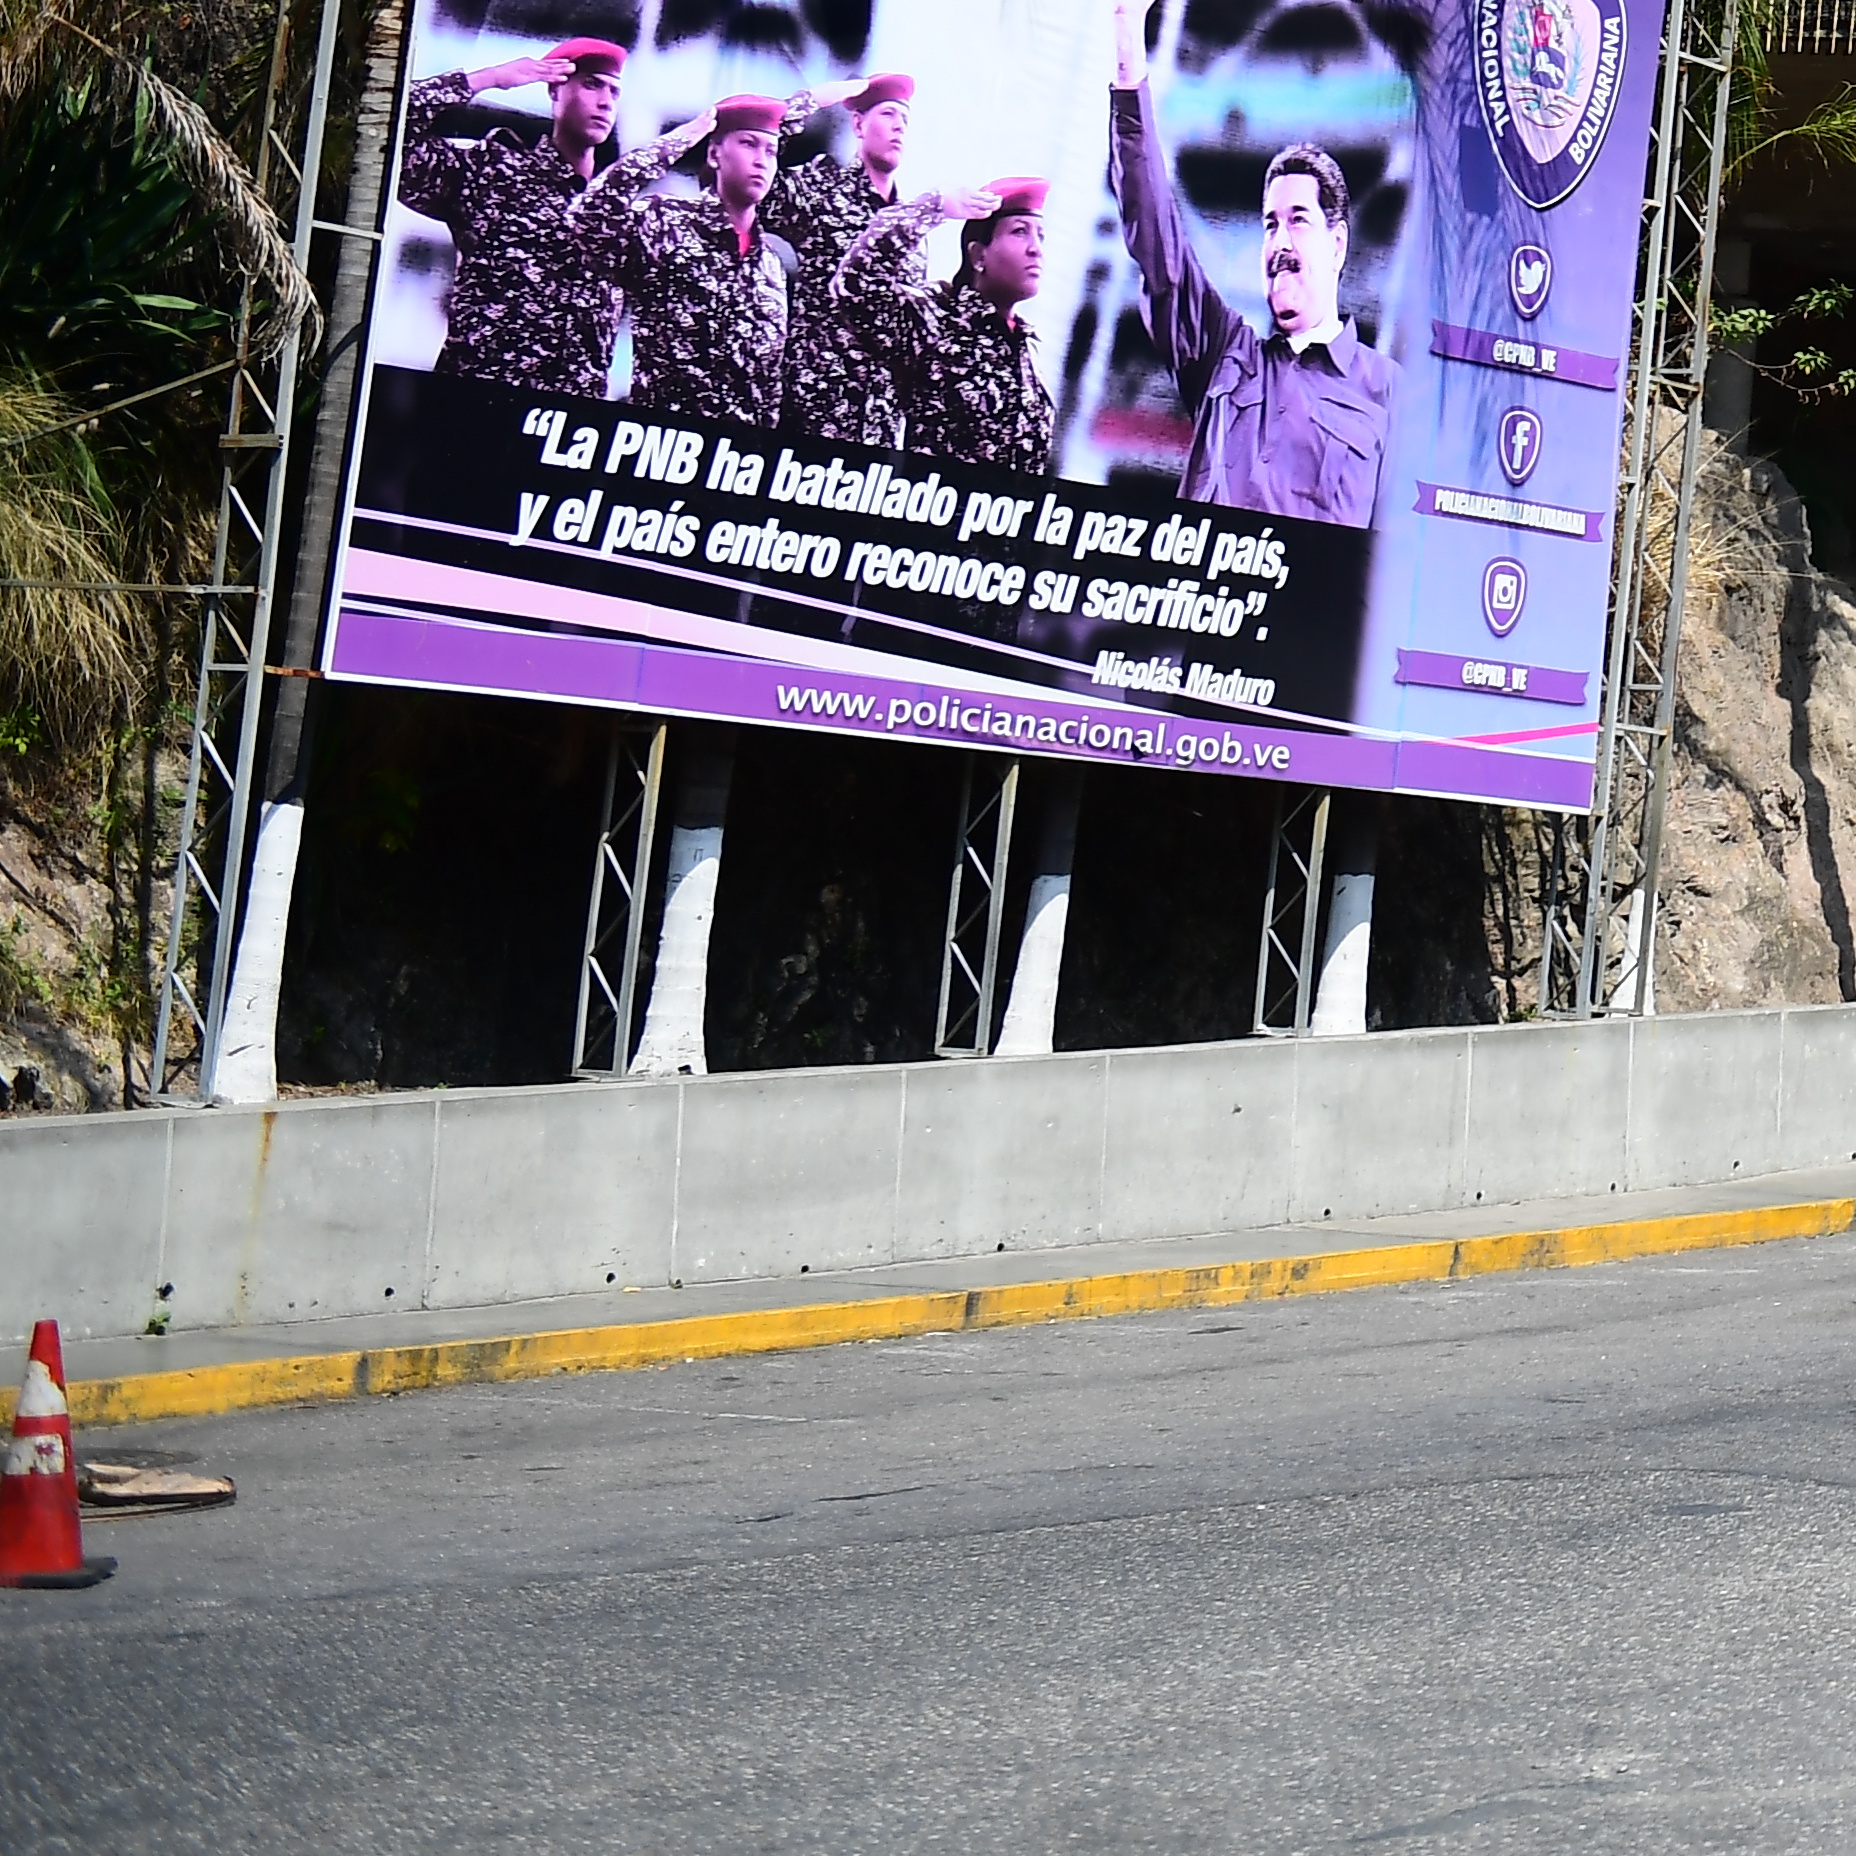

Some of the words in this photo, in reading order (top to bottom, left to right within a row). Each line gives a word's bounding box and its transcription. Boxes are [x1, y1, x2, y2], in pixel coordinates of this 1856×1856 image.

[1568, 16, 1621, 164] BOLIVARIANA
[509, 492, 550, 546] y
[552, 489, 604, 542] el
[600, 500, 700, 558] país
[705, 518, 841, 578] entero
[844, 541, 1026, 605] reconoce
[1028, 569, 1080, 613] su
[604, 420, 704, 485] PNB
[705, 437, 764, 496] ha
[768, 448, 958, 527] batallado
[958, 490, 1034, 542] por
[1033, 493, 1074, 546] la
[1073, 511, 1148, 560] paz
[1150, 513, 1212, 566] del
[1206, 528, 1290, 590] país,
[776, 684, 1290, 769] www.policianacional.gob.ve
[1091, 650, 1183, 694] Nicolás
[1184, 662, 1276, 706] Maduro
